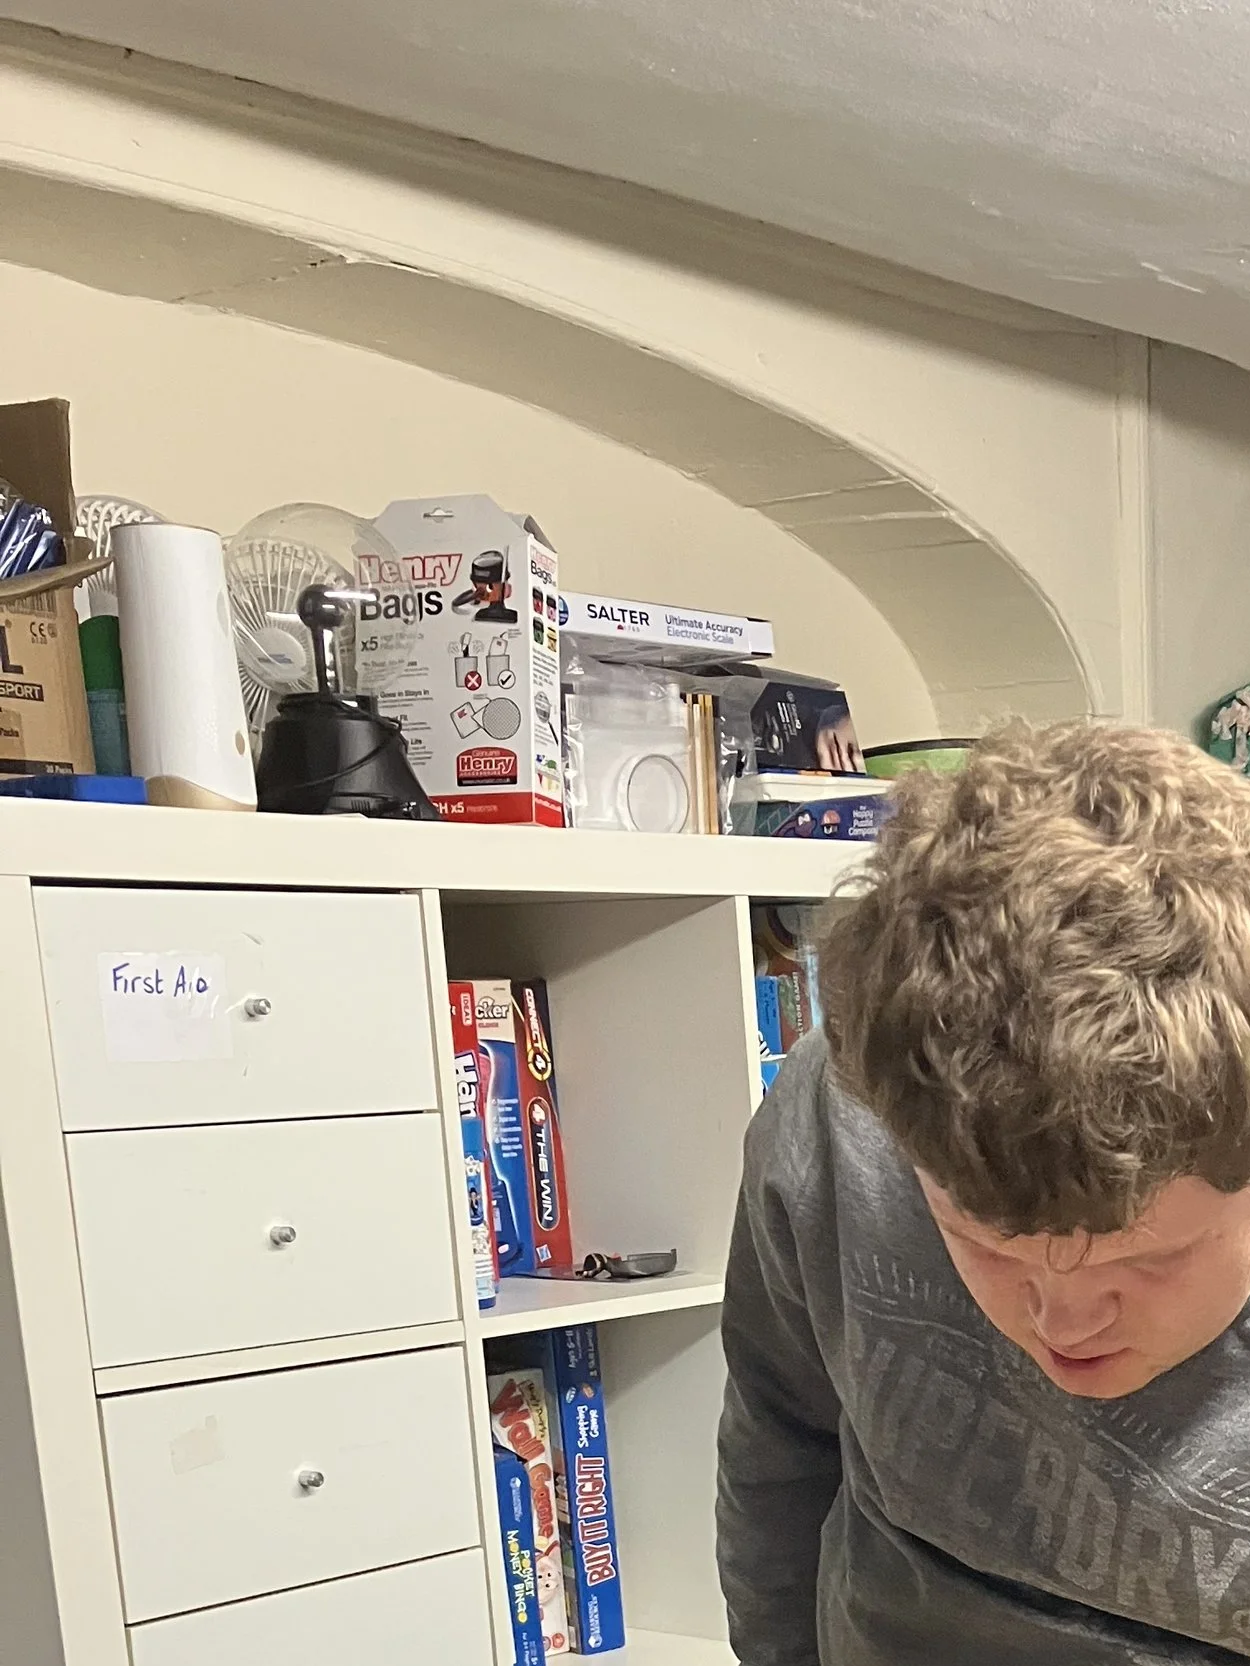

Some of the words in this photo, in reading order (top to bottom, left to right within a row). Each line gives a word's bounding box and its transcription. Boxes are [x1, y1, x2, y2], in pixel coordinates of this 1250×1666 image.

[531, 560, 552, 585] Bags
[587, 604, 650, 626] SALTER
[665, 614, 704, 629] Ultimate
[706, 621, 744, 637] Accuracy
[361, 636, 379, 652] x5
[667, 626, 711, 641] Electronic
[712, 631, 734, 645] Scale
[460, 756, 514, 775] Henry
[451, 802, 464, 813] x5
[853, 818, 874, 828] Puzzle
[113, 962, 164, 995] First
[462, 995, 471, 1022] IDEAL
[525, 988, 542, 1048] CONNECT
[534, 1054, 546, 1071] 4
[532, 1103, 546, 1122] 4
[536, 1128, 549, 1173] THE
[540, 1179, 554, 1221] WIN
[577, 1405, 591, 1448] Shopping
[589, 1409, 600, 1438] Game
[491, 1379, 546, 1460] Wall
[529, 1462, 555, 1538] Game
[576, 1454, 607, 1518] RIGHT
[577, 1521, 607, 1542] IT
[505, 1530, 523, 1577] MONEY
[582, 1542, 616, 1587] BUY
[520, 1550, 535, 1597] POCKET
[512, 1583, 529, 1624] BINGO
